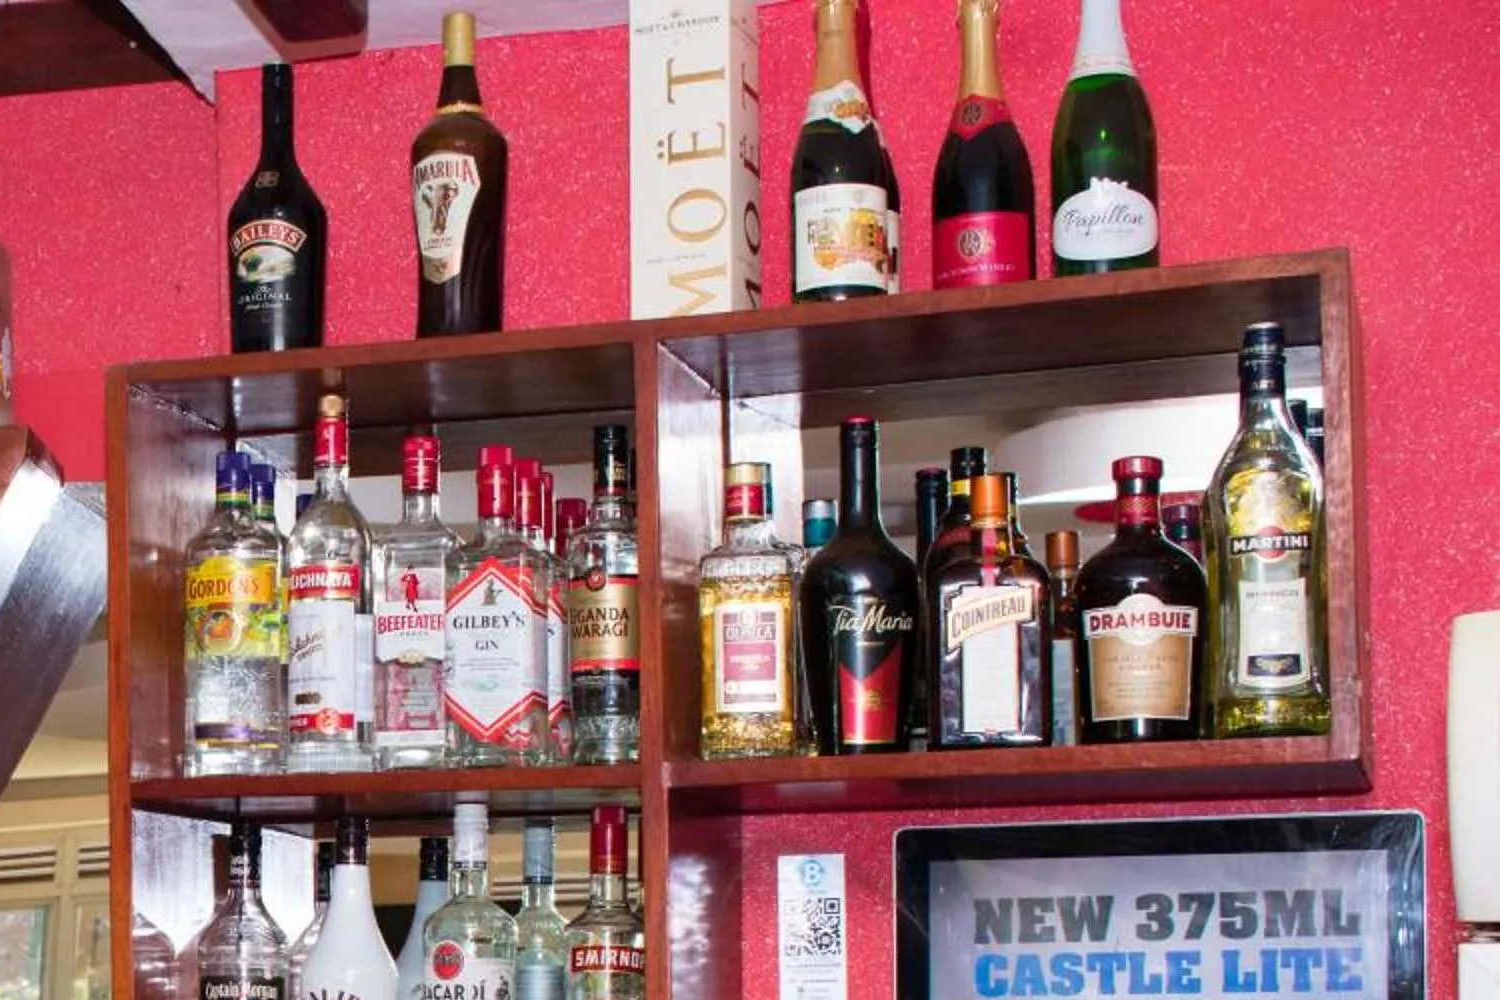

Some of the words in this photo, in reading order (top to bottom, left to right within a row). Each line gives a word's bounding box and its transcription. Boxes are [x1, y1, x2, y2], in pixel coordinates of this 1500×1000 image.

[414, 157, 477, 188] AMARULA
[657, 57, 728, 318] MOËT
[233, 224, 301, 249] BAILEYS
[1231, 535, 1309, 555] MARTINI
[376, 613, 443, 636] BEEFEATER
[452, 610, 526, 631] GILBEY'S
[569, 607, 630, 626] UGANDA
[826, 605, 861, 636] Tia
[860, 604, 914, 634] Maria
[951, 595, 1026, 639] COINTREAU
[1089, 609, 1192, 632] DRAMBUIE
[571, 622, 628, 639] WARAGI
[474, 639, 499, 651] GIN
[973, 895, 1114, 945] NEW
[1134, 889, 1362, 941] 375ML
[574, 950, 644, 969] SMIRNO
[975, 949, 1201, 998] CASTLE
[1221, 947, 1364, 994] LITE
